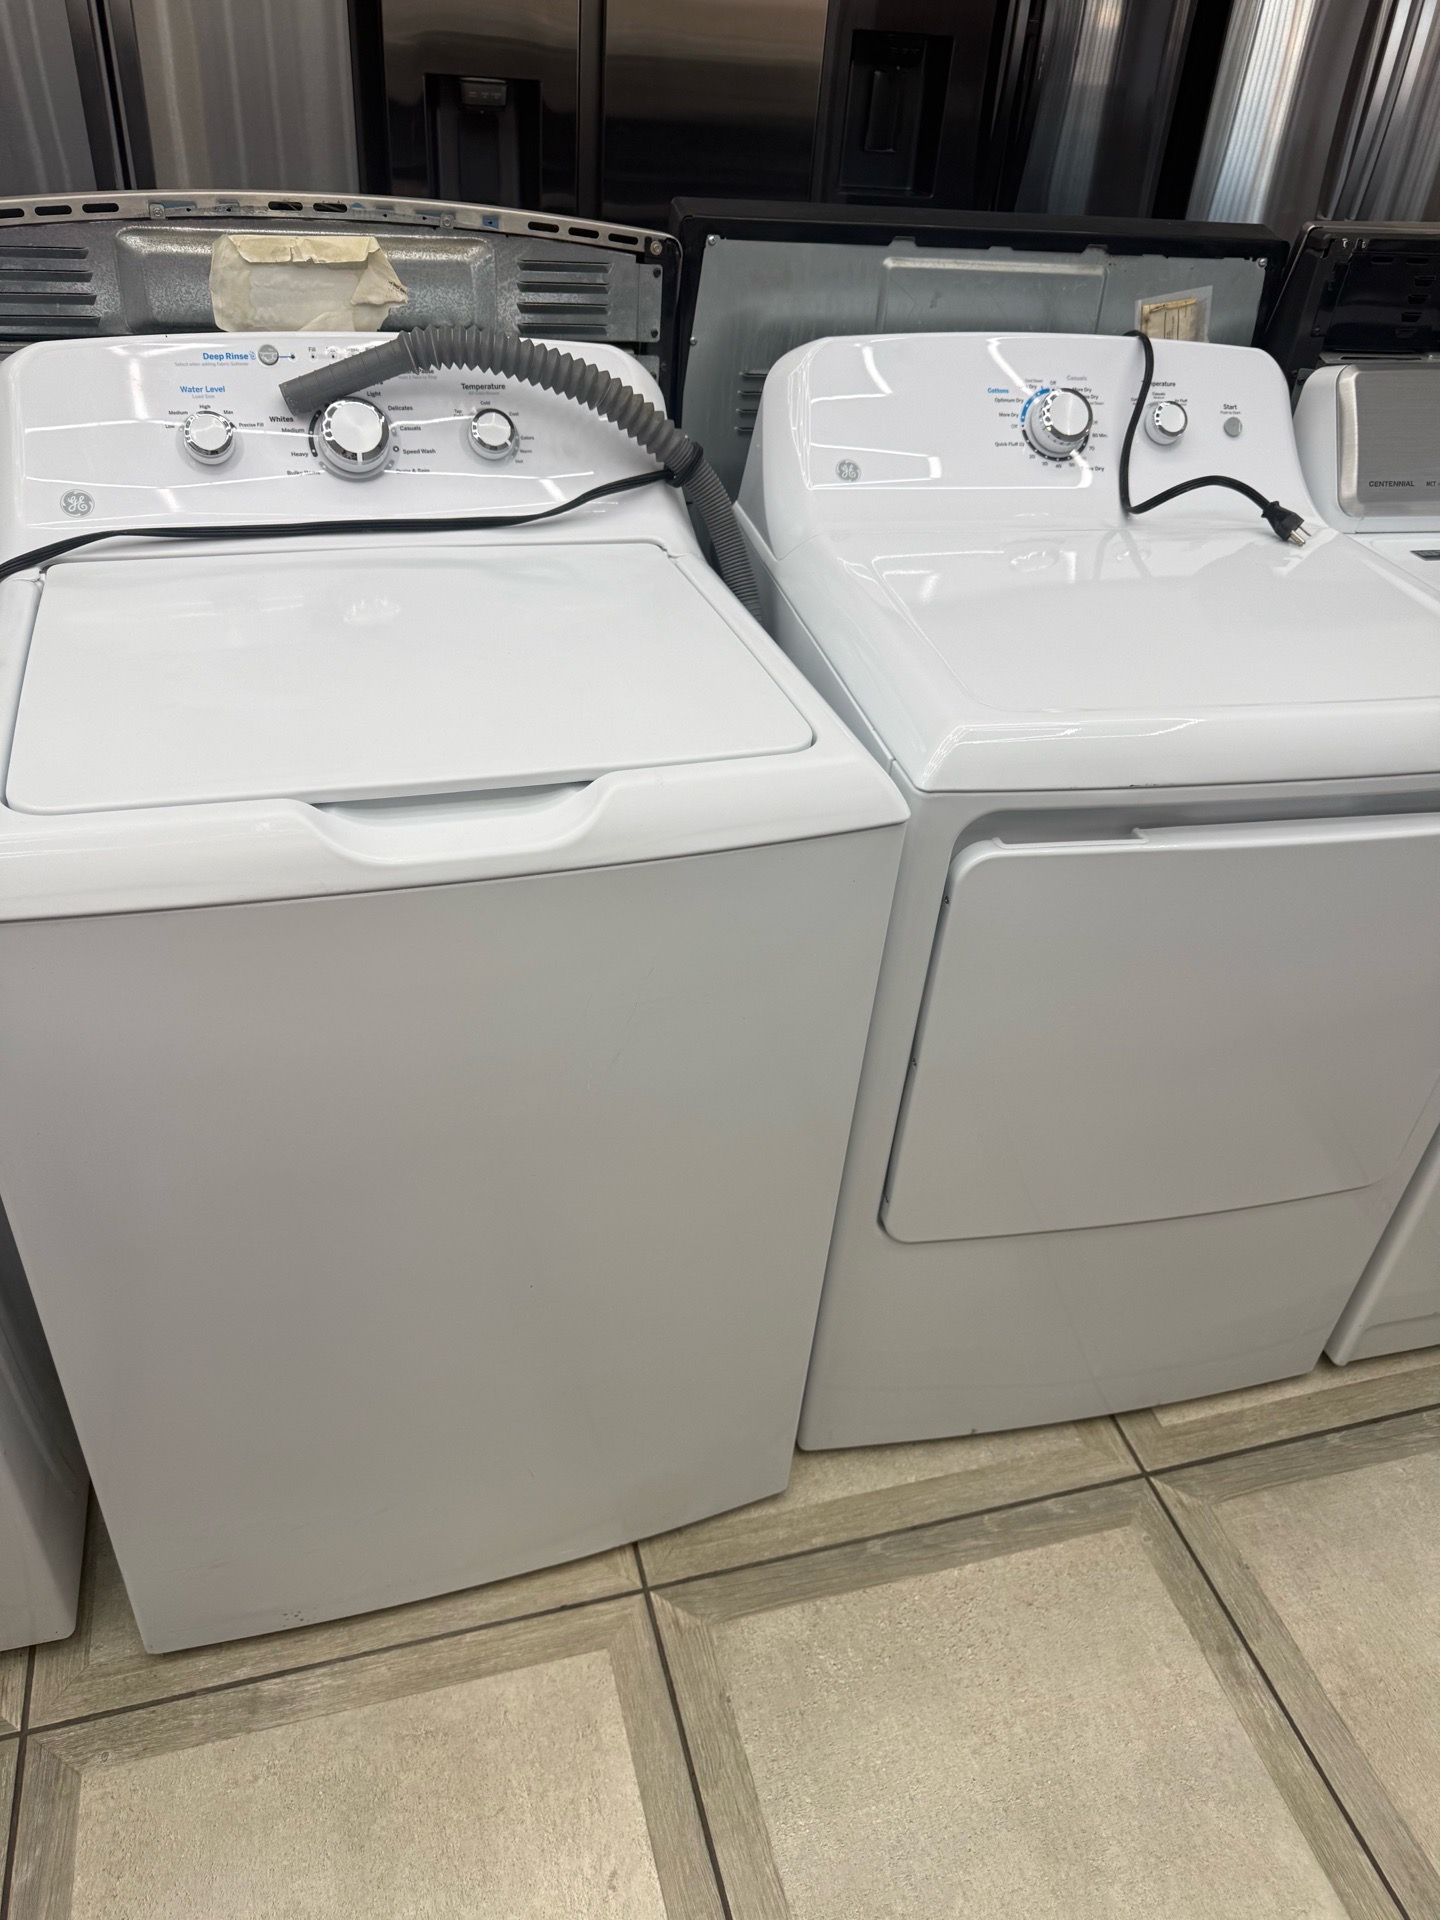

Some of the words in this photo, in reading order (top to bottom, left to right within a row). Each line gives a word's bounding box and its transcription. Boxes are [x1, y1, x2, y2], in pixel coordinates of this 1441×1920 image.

[202, 352, 225, 362] Deep
[225, 352, 249, 360] Rinse
[180, 385, 203, 393] Water
[205, 385, 226, 393] Level
[460, 383, 506, 391] Temperature
[1368, 480, 1415, 488] CENTENNIAL
